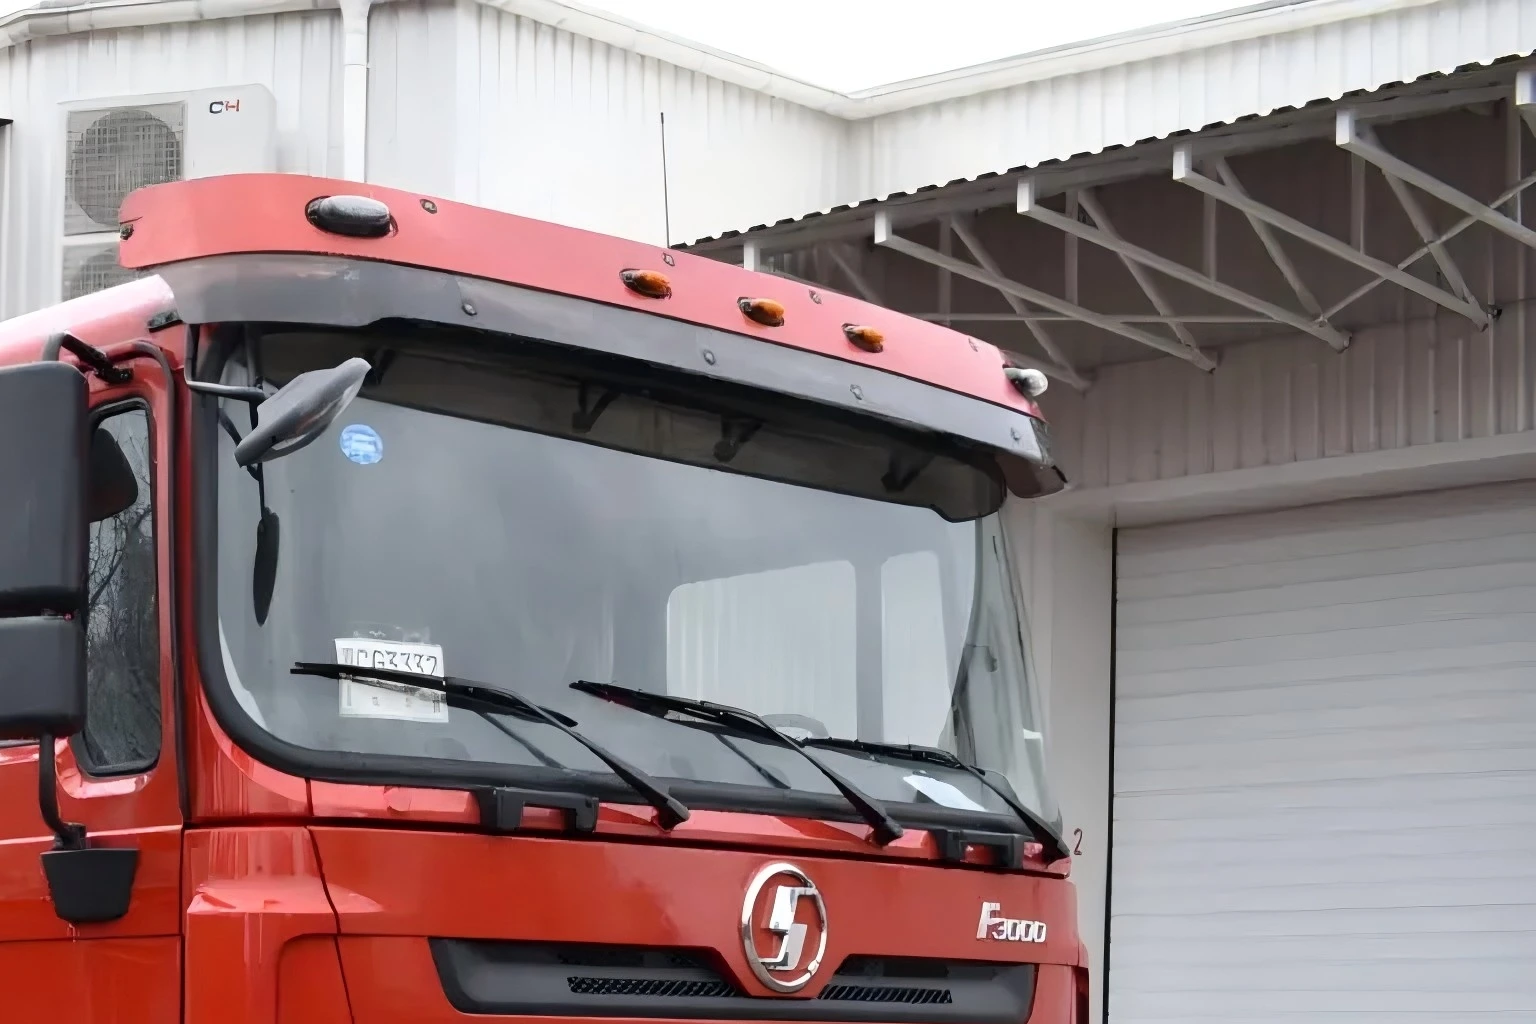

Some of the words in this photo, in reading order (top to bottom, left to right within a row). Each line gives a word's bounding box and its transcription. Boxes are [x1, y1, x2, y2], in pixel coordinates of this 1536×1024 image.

[209, 99, 240, 114] CH
[1073, 827, 1083, 856] 2
[976, 901, 1047, 943] F3000
